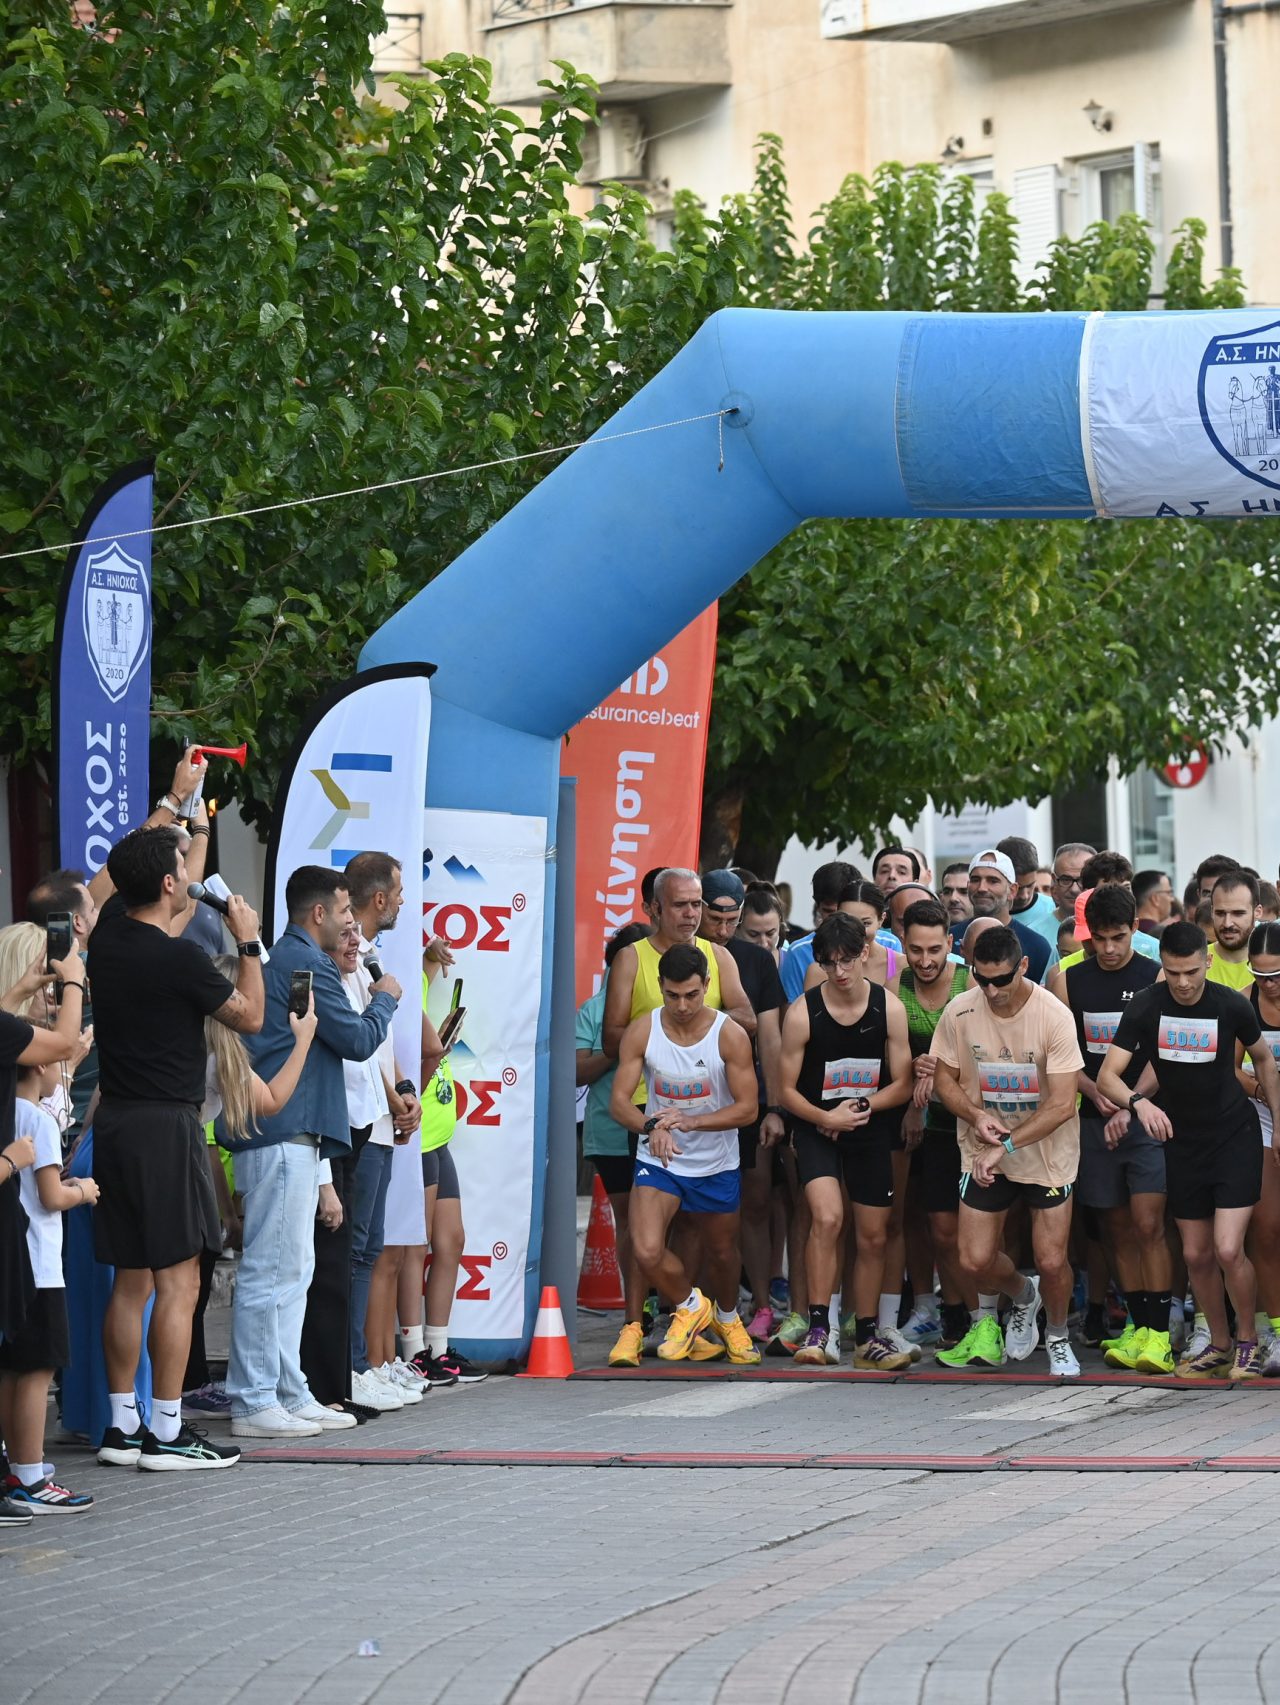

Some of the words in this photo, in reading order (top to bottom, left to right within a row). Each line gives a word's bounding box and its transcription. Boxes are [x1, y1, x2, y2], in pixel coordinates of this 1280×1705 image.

[1215, 346, 1246, 362] Α.Σ.
[105, 667, 124, 680] 2020
[585, 705, 700, 729] surancebeat
[118, 723, 127, 777] 2020
[85, 720, 115, 886] ΟΧΟΣ
[117, 784, 129, 825] est.
[1090, 1025, 1119, 1040] 515
[831, 1070, 873, 1086] 5164
[987, 1074, 1030, 1090] 5061
[662, 1082, 703, 1098] 5163
